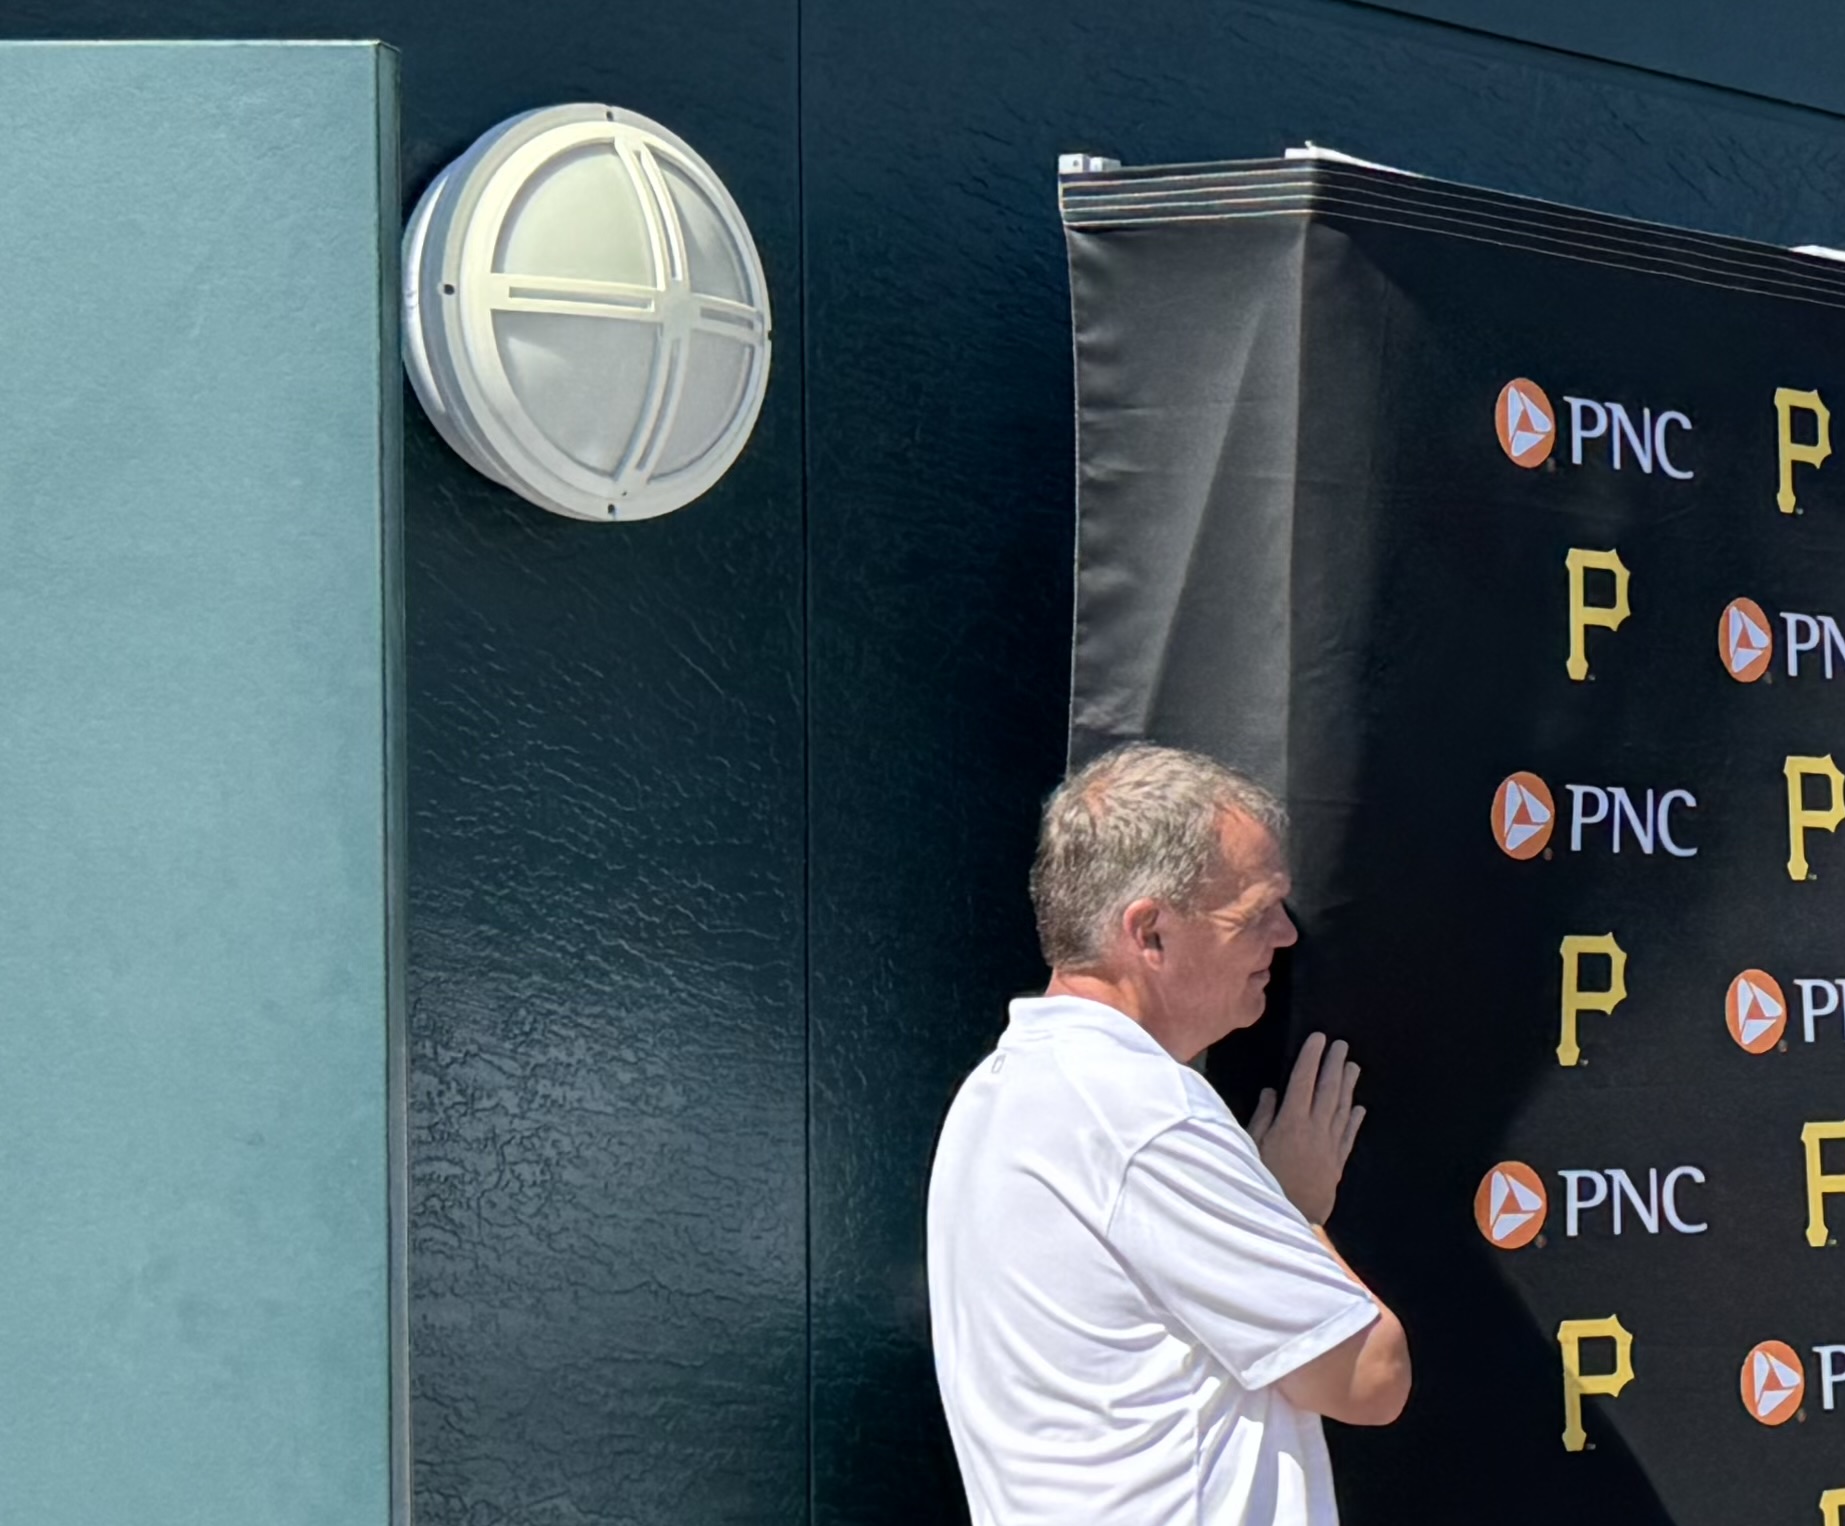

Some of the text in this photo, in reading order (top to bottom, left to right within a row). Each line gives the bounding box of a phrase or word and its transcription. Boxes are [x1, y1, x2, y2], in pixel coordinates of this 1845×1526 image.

[1562, 396, 1694, 480] PNC
[1775, 388, 1832, 514] P
[1566, 548, 1631, 681] P
[1565, 784, 1698, 858] PNC
[1556, 933, 1628, 1067] P
[1557, 1165, 1708, 1237] PNC
[1557, 1314, 1635, 1452] P
